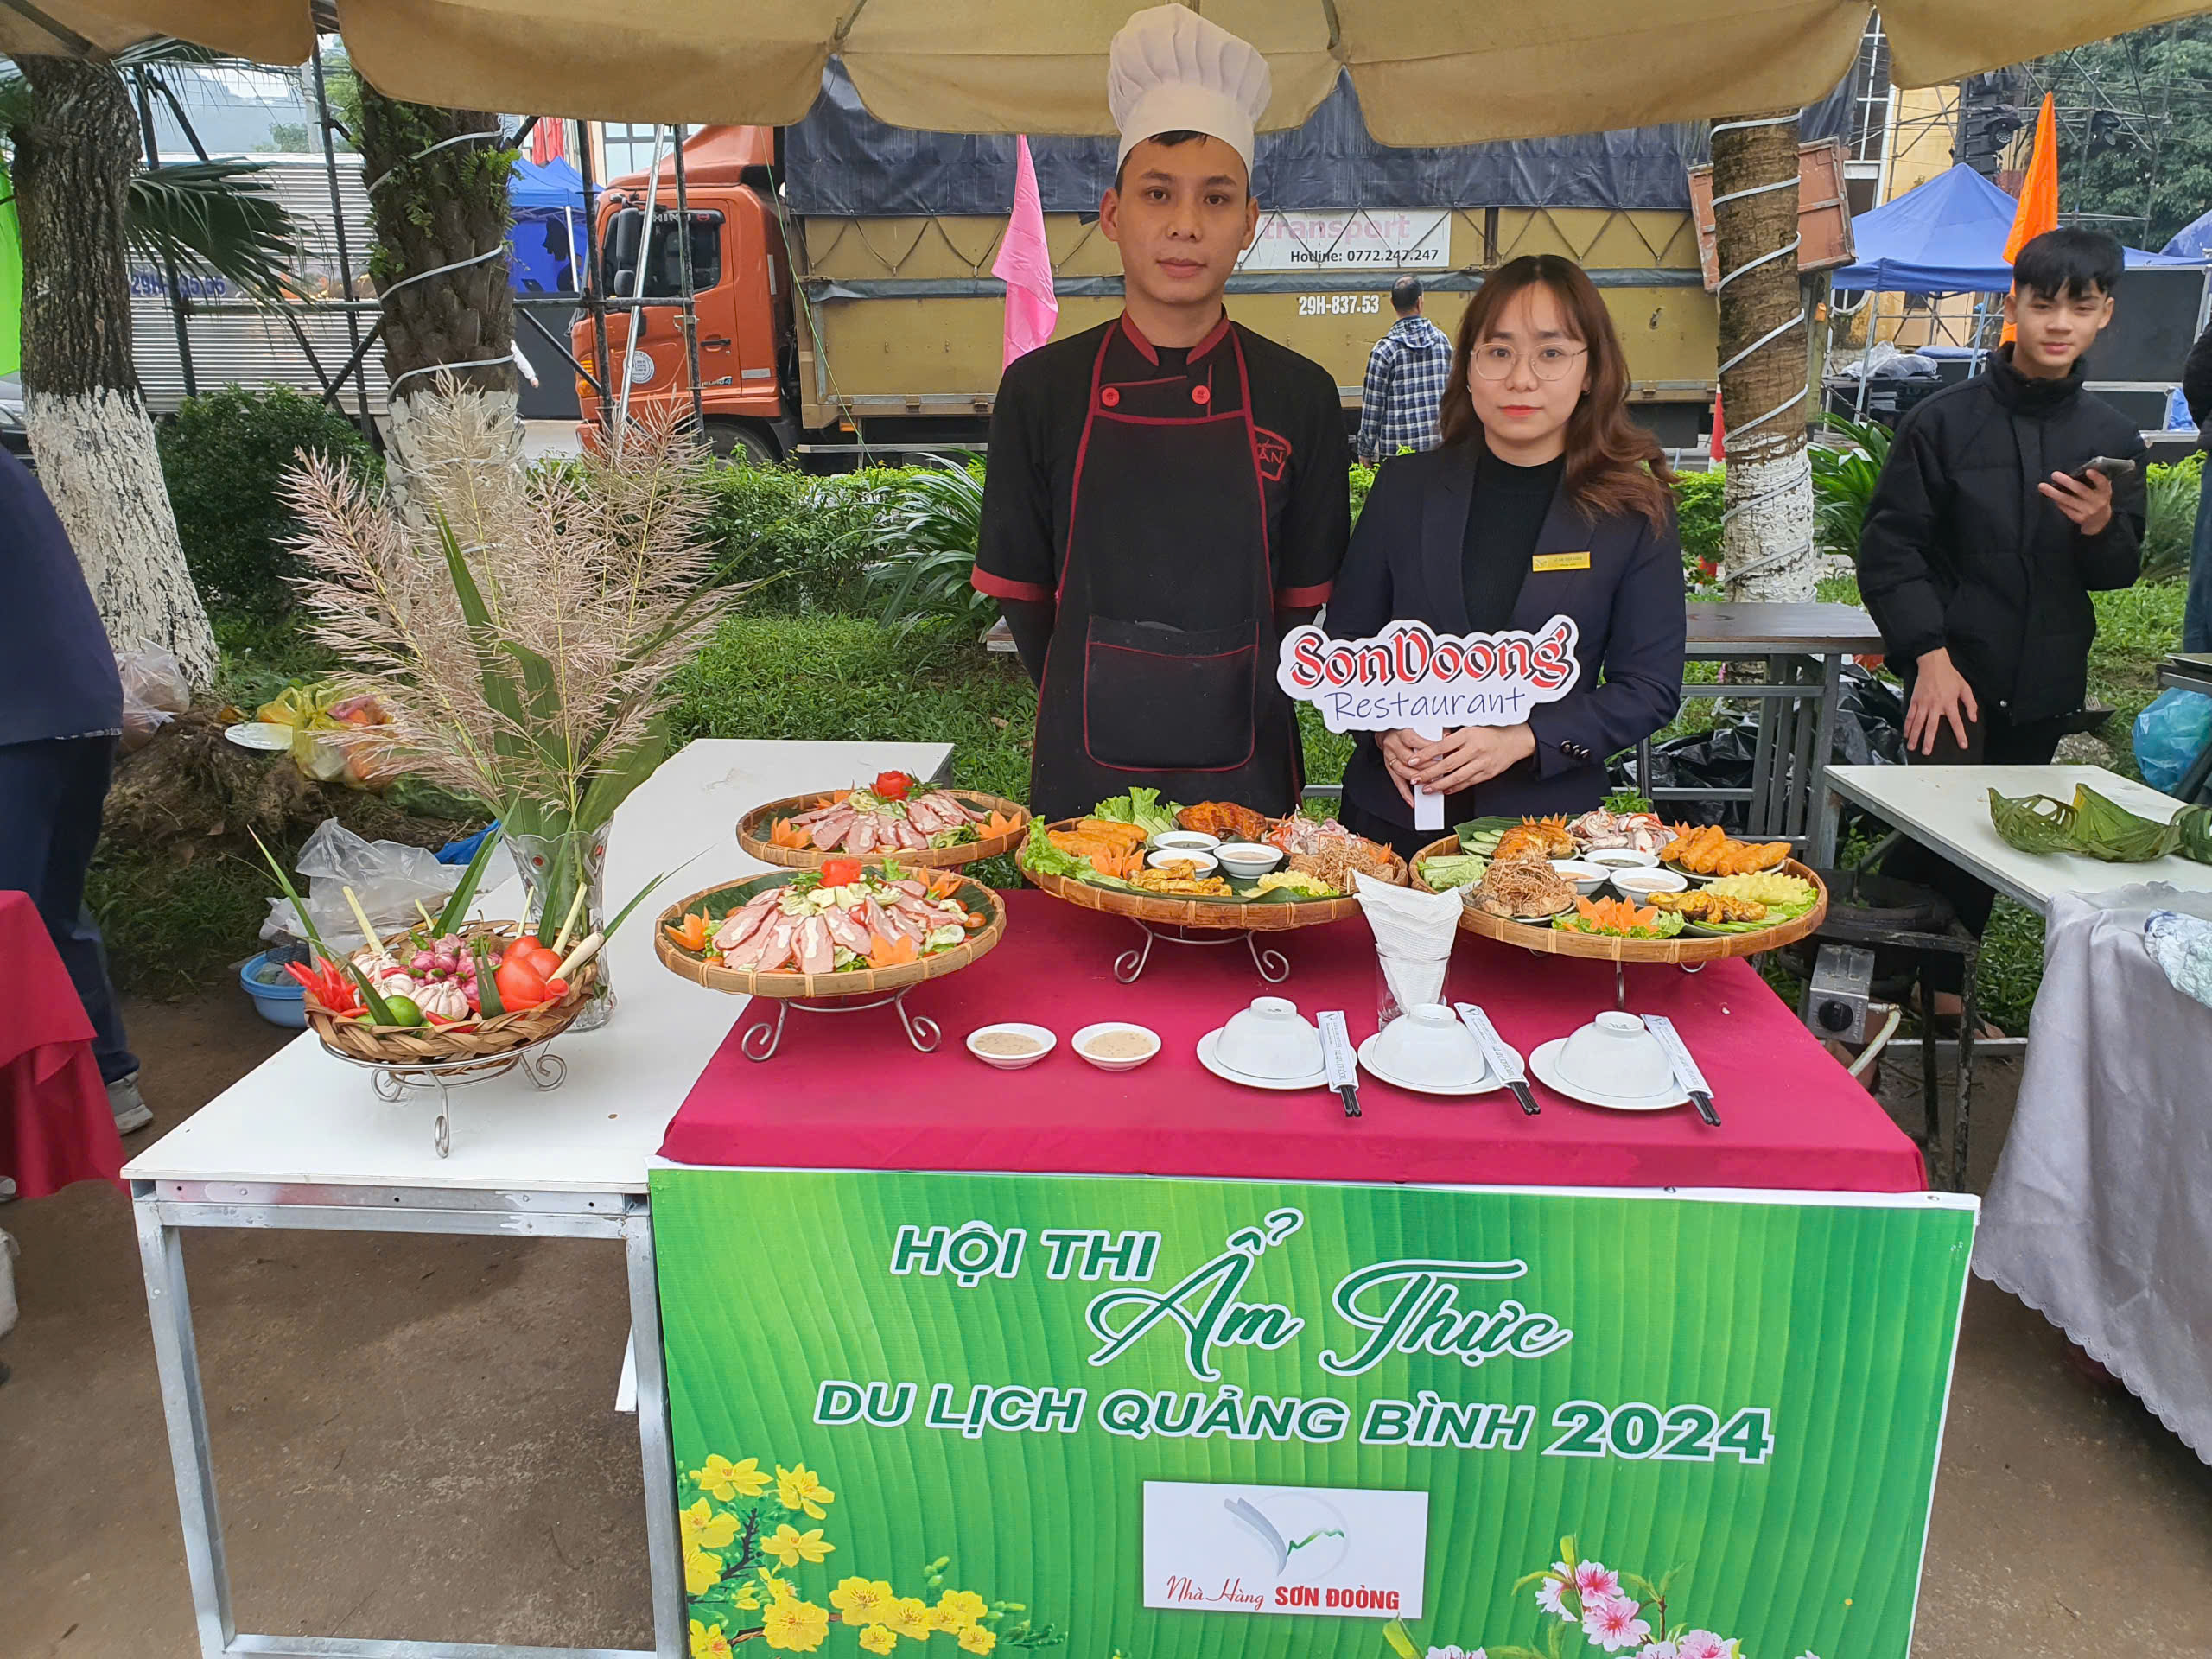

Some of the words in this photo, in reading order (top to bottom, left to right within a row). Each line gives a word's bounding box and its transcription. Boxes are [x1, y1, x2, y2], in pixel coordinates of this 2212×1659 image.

[1263, 215, 1410, 245] transport
[1291, 251, 1343, 263] Hotline:
[1347, 250, 1439, 262] 0772.247.247
[1299, 295, 1380, 315] 29H-837.53
[1324, 687, 1525, 721] Restaurant
[890, 1221, 1027, 1287] HỘI
[1040, 1230, 1161, 1281] THI
[1085, 1207, 1305, 1381] Ẩm
[1318, 1258, 1573, 1376] Thực
[813, 1380, 917, 1427] DU
[925, 1384, 1087, 1439] LỊCH
[1098, 1388, 1351, 1442] QUẢNG
[1359, 1390, 1535, 1451] BÌNH
[1541, 1400, 1774, 1464] 2024
[1166, 1575, 1204, 1604] Nhà
[1206, 1578, 1264, 1611] Hàng
[1274, 1585, 1319, 1607] SƠN
[1325, 1584, 1400, 1610] ĐOÒNG
